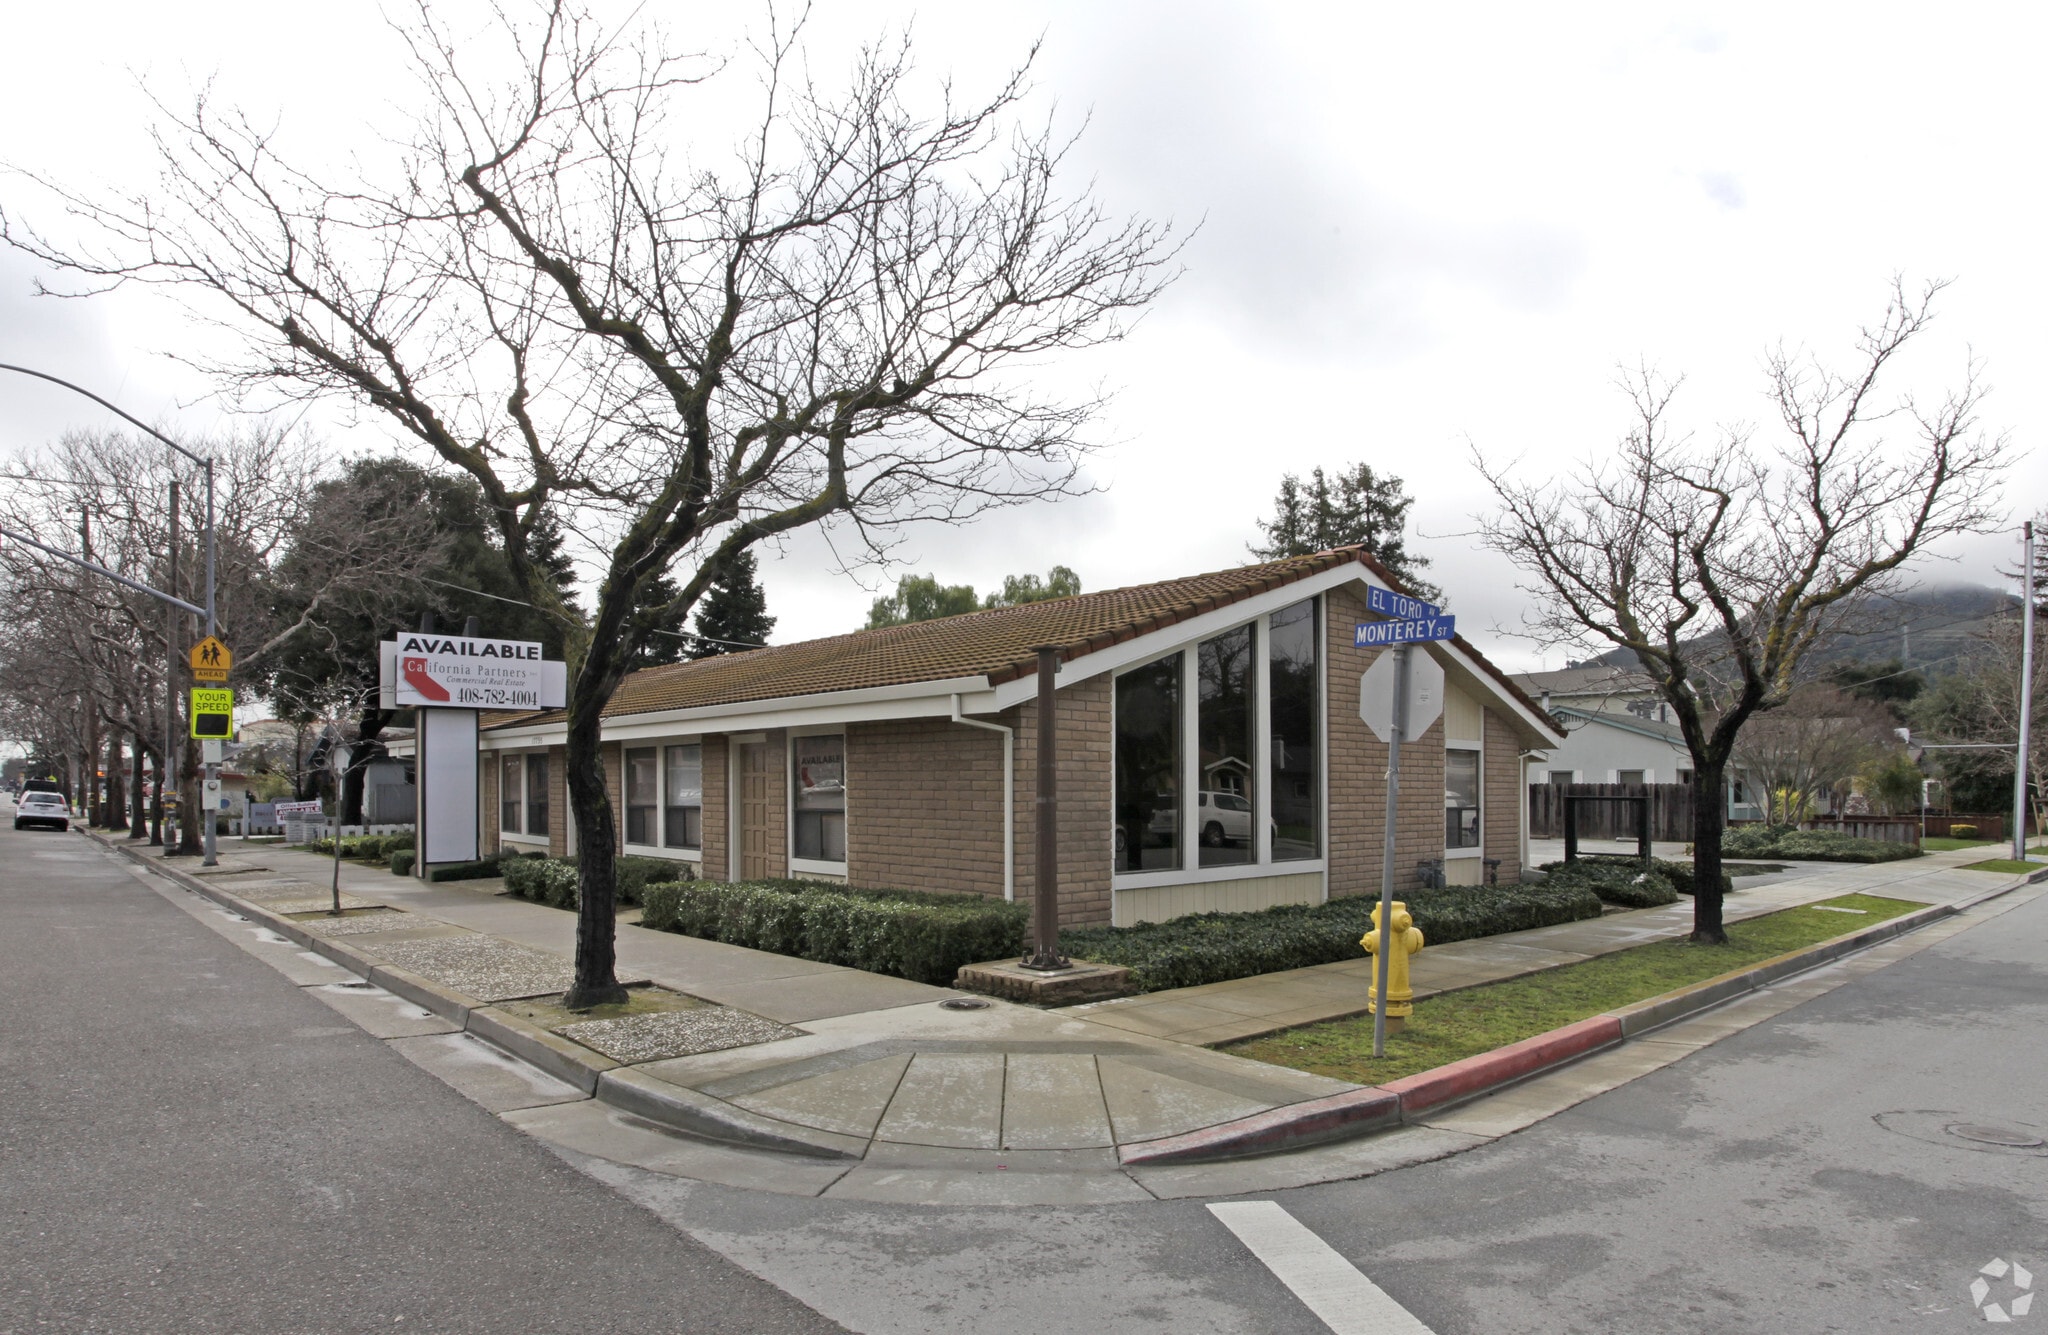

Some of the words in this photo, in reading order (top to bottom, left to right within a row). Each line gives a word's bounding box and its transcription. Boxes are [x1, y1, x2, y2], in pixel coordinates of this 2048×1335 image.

[1372, 590, 1385, 610] EL
[1392, 595, 1422, 619] TORO
[1356, 619, 1437, 643] MONTEREY
[1437, 626, 1448, 637] ST
[403, 637, 539, 660] AVAILABLE
[407, 660, 471, 675] California
[478, 665, 527, 678] Partners
[446, 675, 489, 685] Commercial
[489, 677, 504, 686] Real
[505, 678, 526, 687] Estate
[197, 693, 227, 702] YOUR
[457, 687, 538, 705] 408-782-4004
[195, 703, 230, 711] SPEED
[801, 754, 840, 765] AVAILABLE
